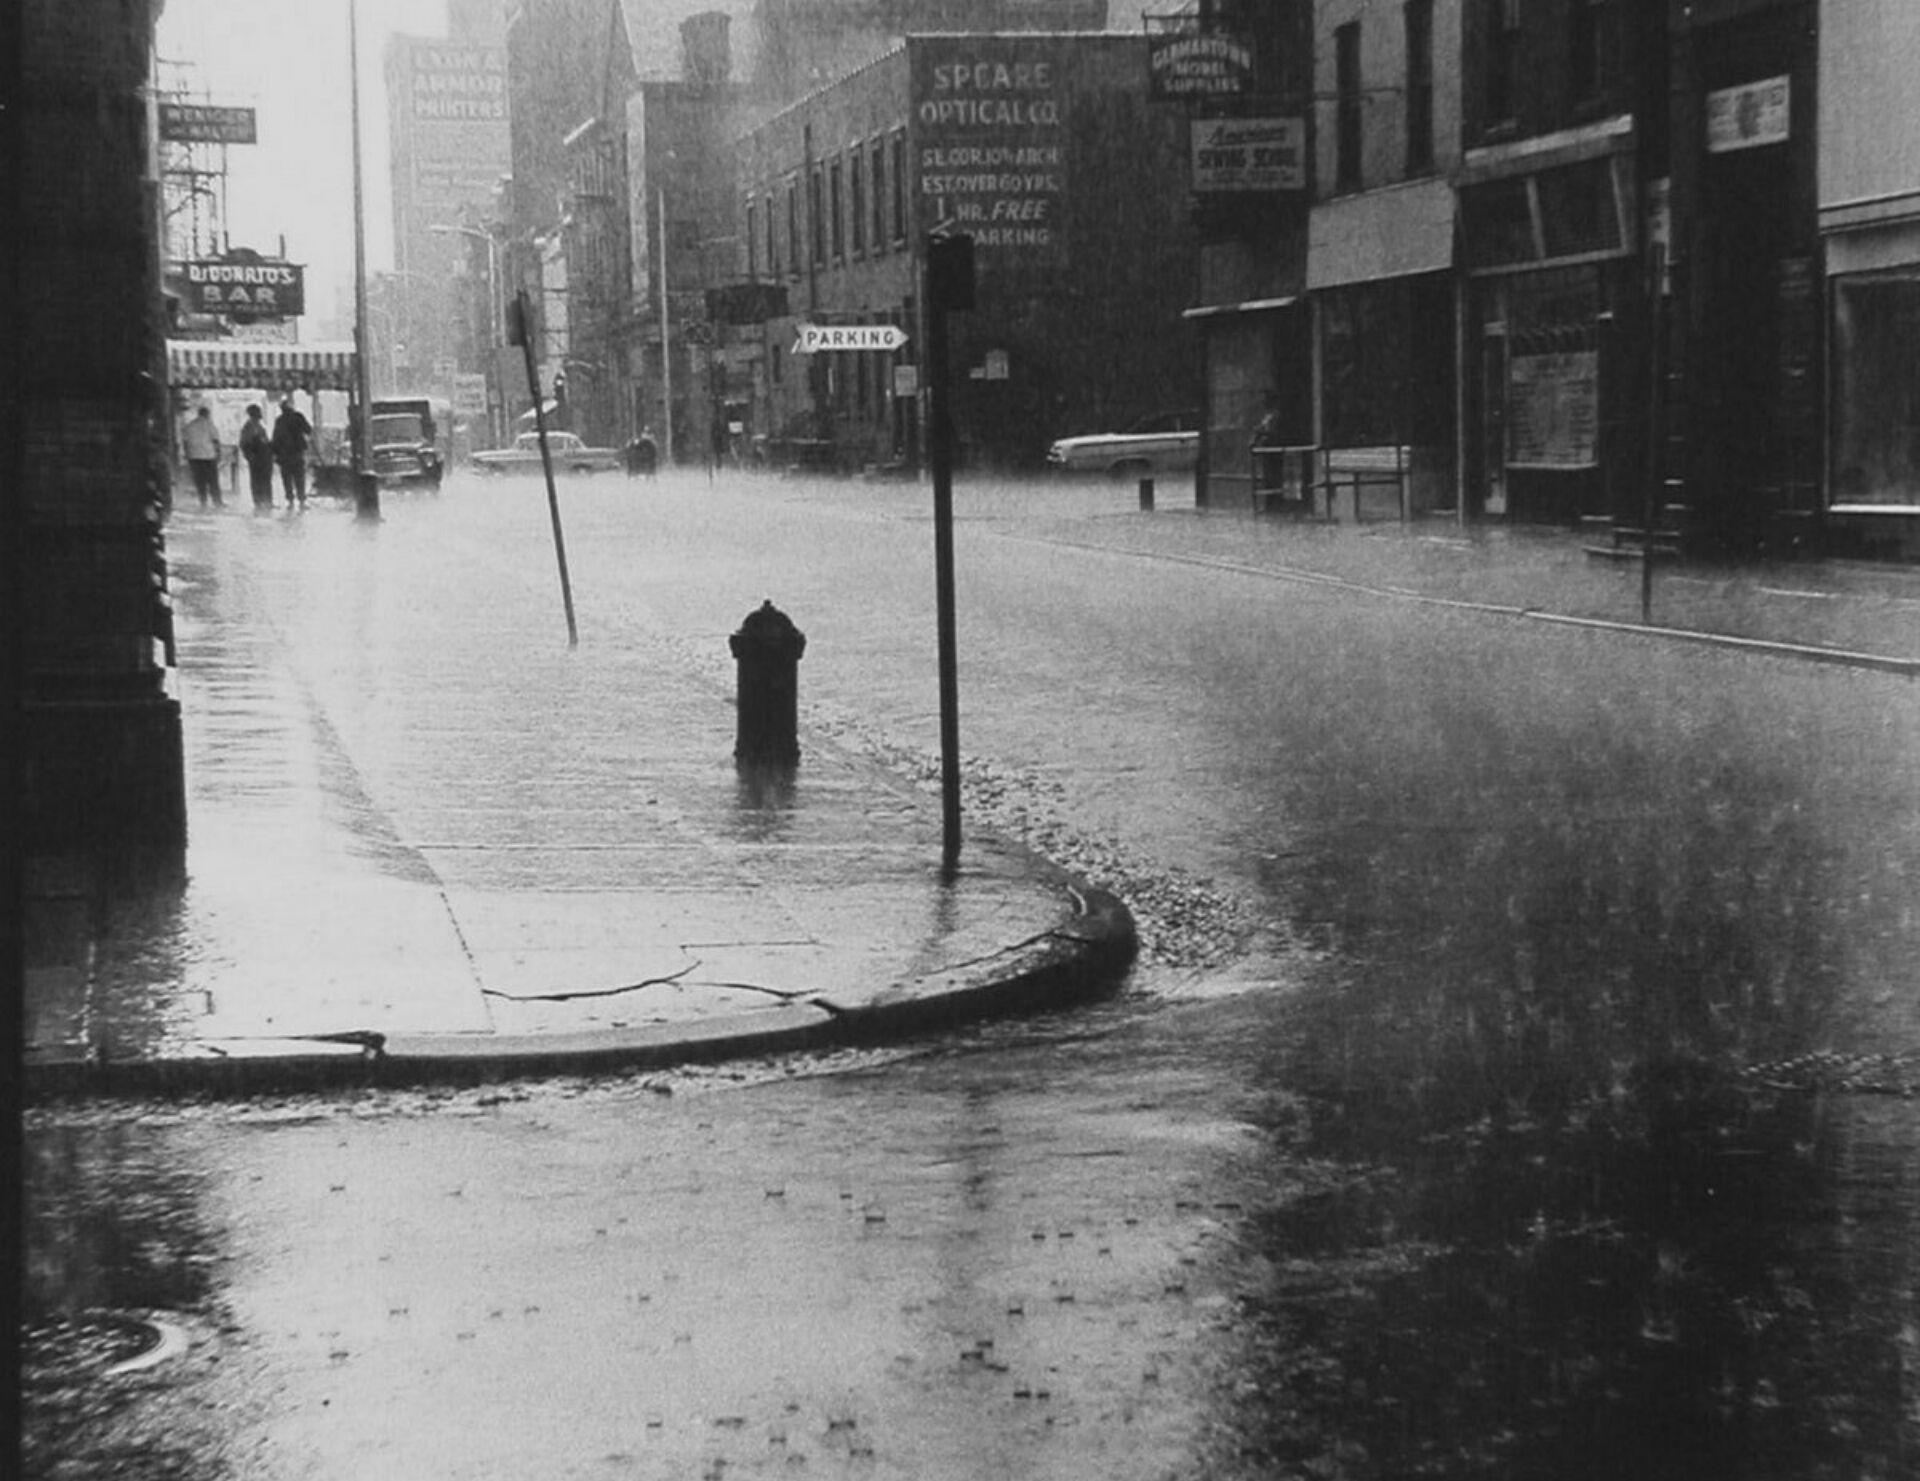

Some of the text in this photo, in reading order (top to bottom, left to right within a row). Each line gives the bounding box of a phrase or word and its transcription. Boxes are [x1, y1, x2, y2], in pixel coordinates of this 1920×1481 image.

[919, 99, 1025, 127] OPTICAL
[956, 174, 997, 192] OVER
[957, 203, 988, 221] HR.
[991, 199, 1050, 221] FREE
[203, 285, 277, 304] BAR
[806, 330, 894, 346] PARKING
